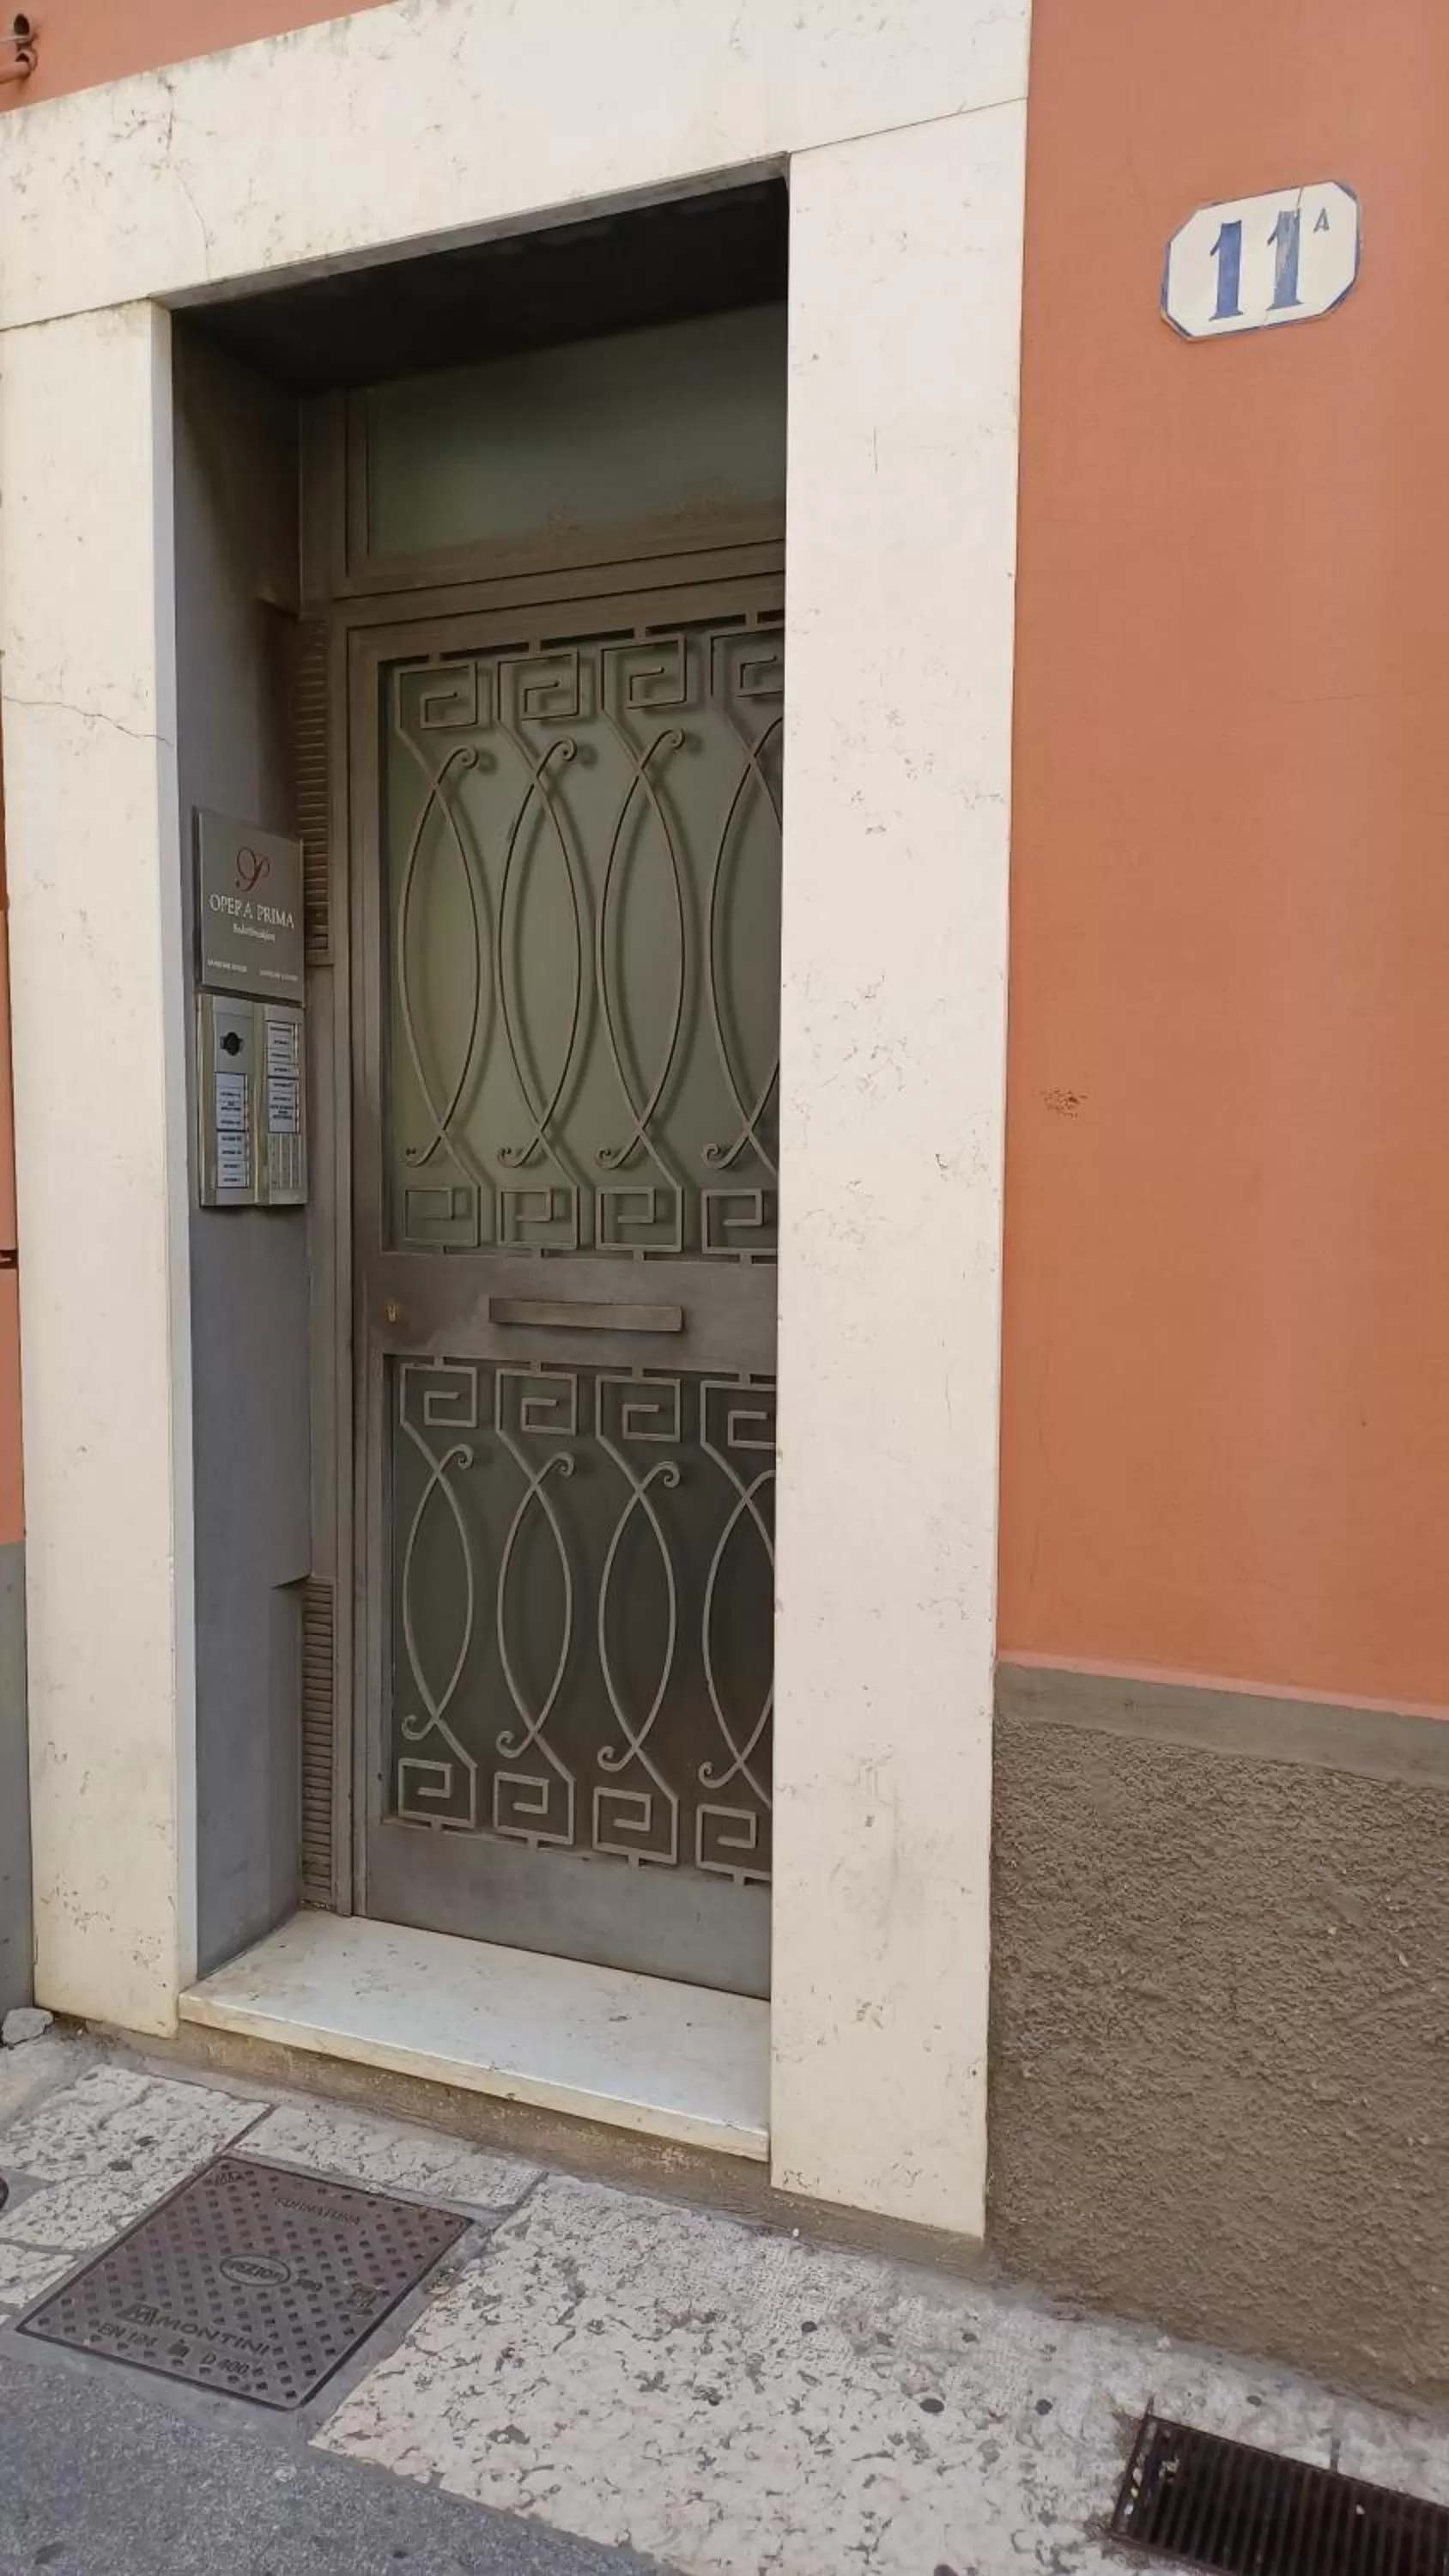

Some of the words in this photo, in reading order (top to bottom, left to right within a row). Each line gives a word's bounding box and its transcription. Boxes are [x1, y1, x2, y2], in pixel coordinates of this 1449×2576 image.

[209, 894, 252, 920] OPERA
[258, 904, 294, 928] PRIMA
[156, 2317, 270, 2356] MONTINI
